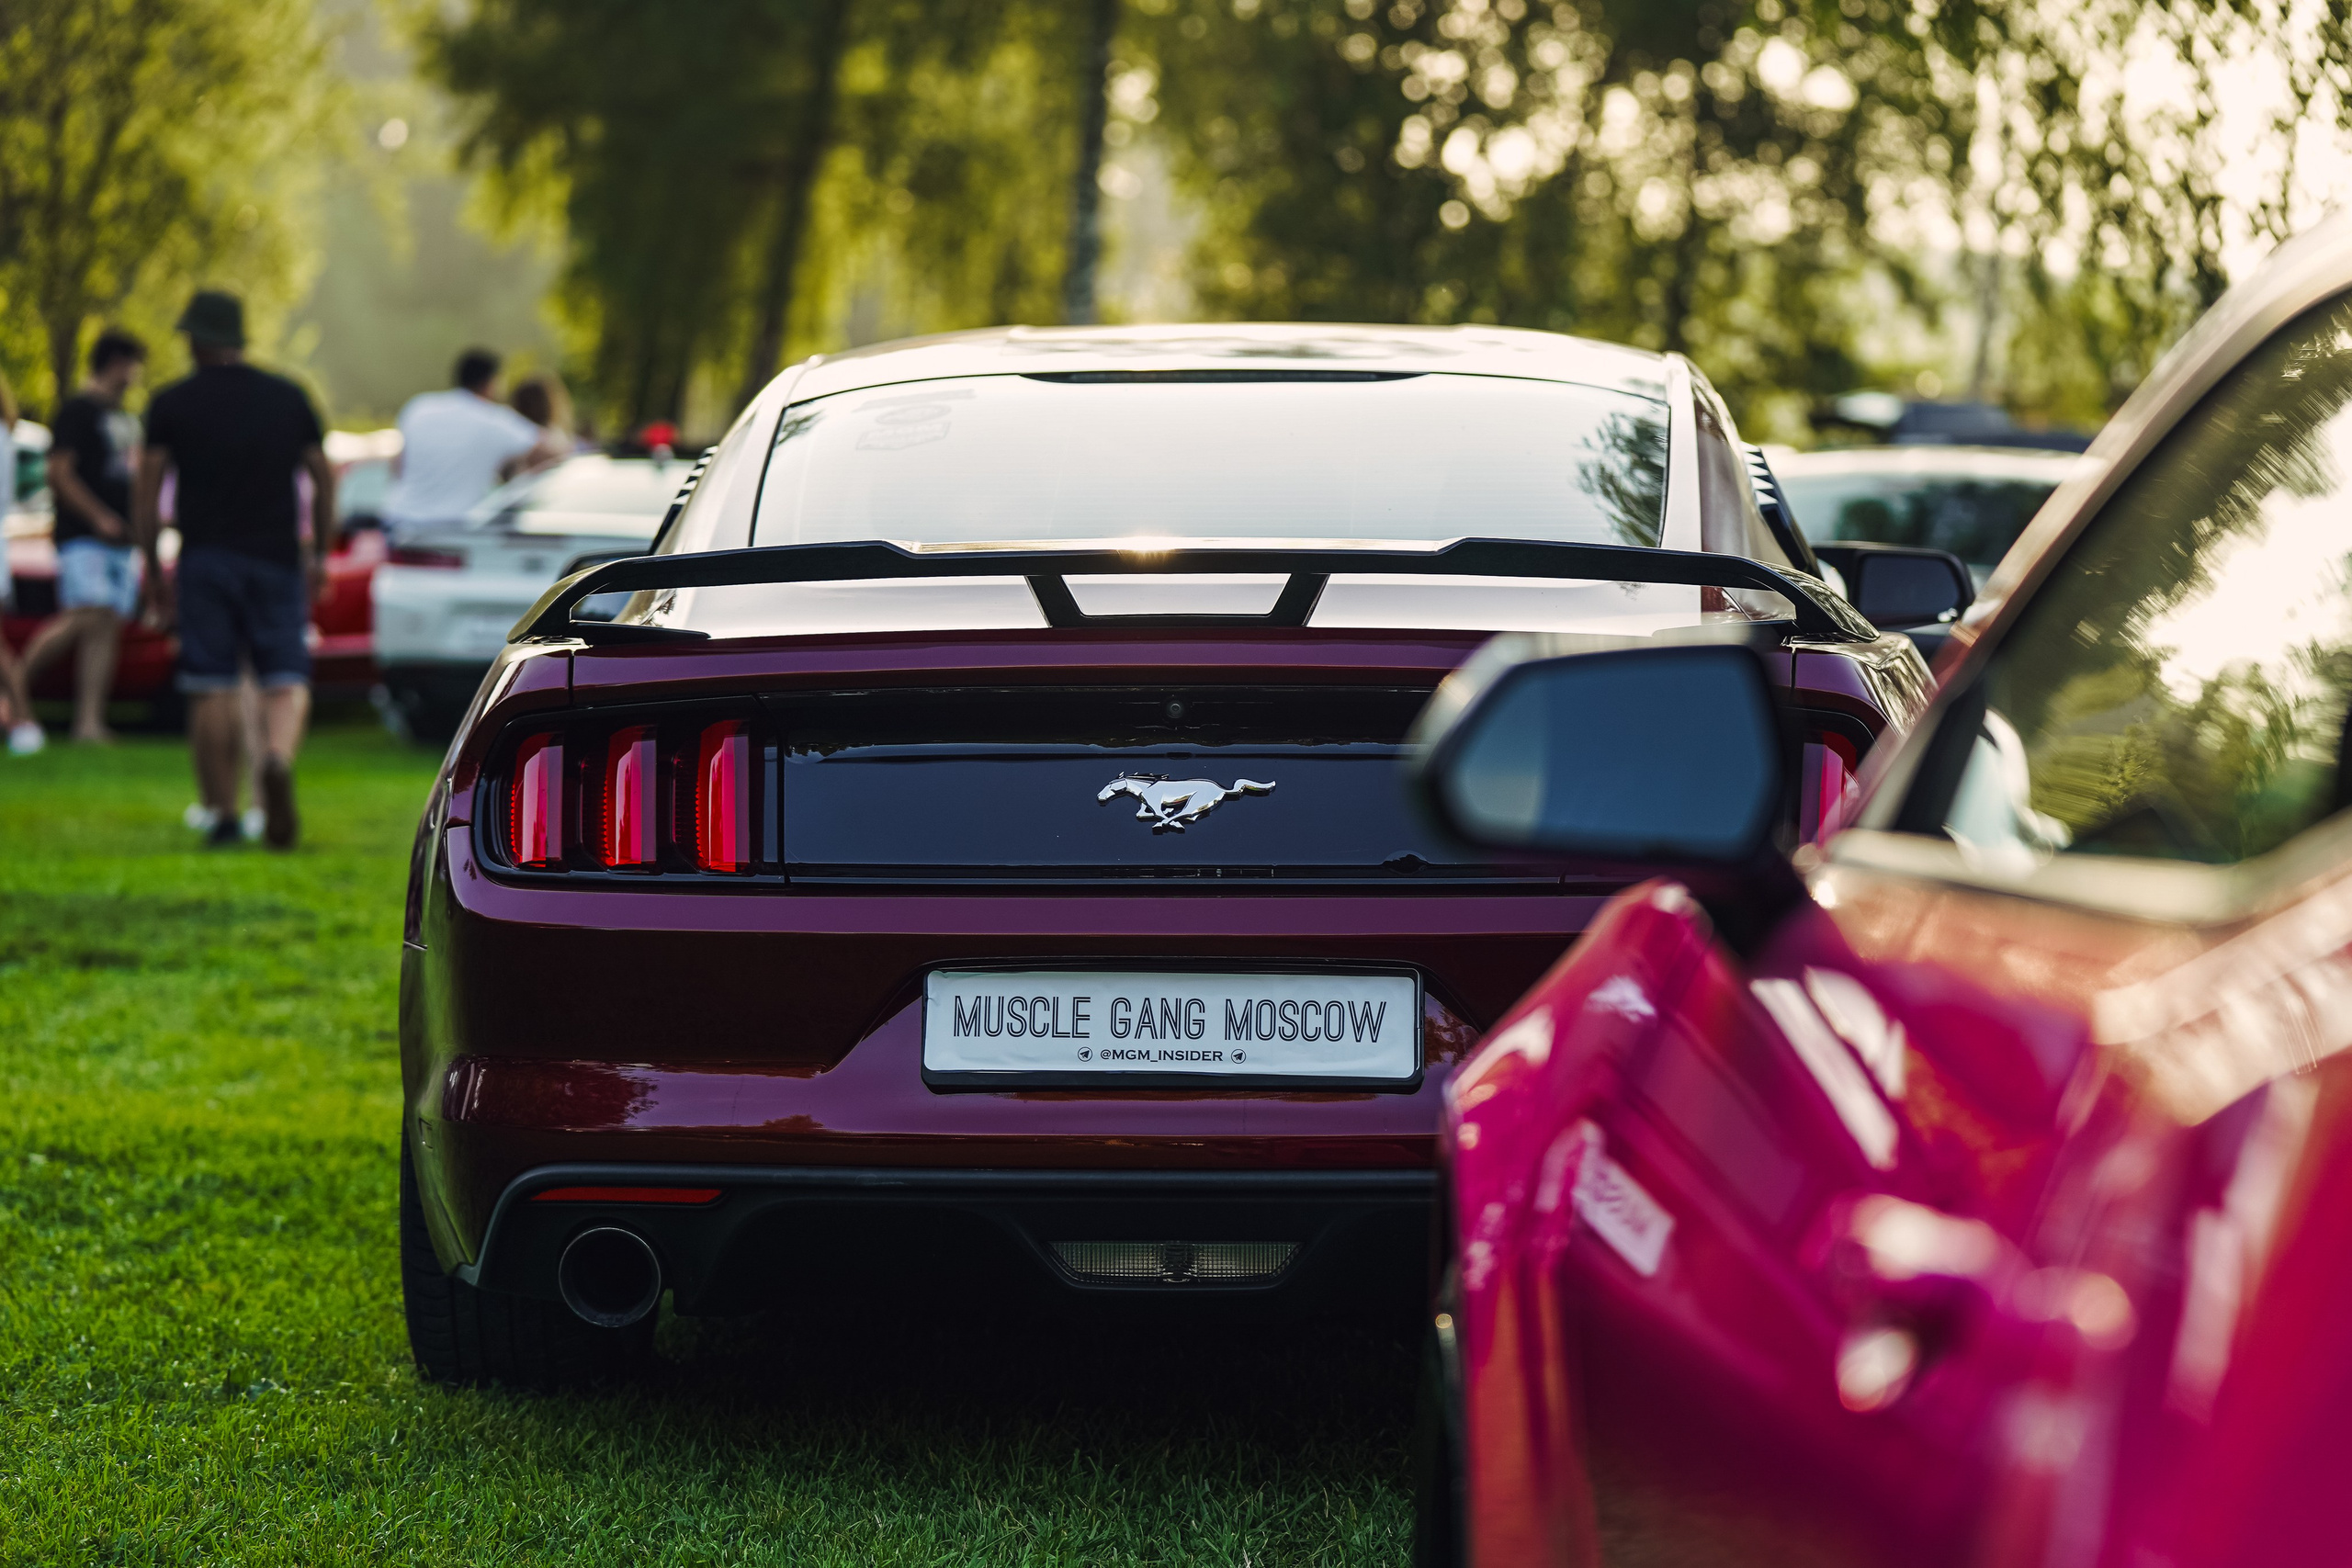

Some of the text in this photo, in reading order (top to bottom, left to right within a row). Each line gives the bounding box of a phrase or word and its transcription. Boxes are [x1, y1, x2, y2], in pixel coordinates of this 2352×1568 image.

[953, 995, 1387, 1043] MUSCLE GANG MOSCOW
[1100, 1049, 1224, 1063] @MGM_INSIDER
